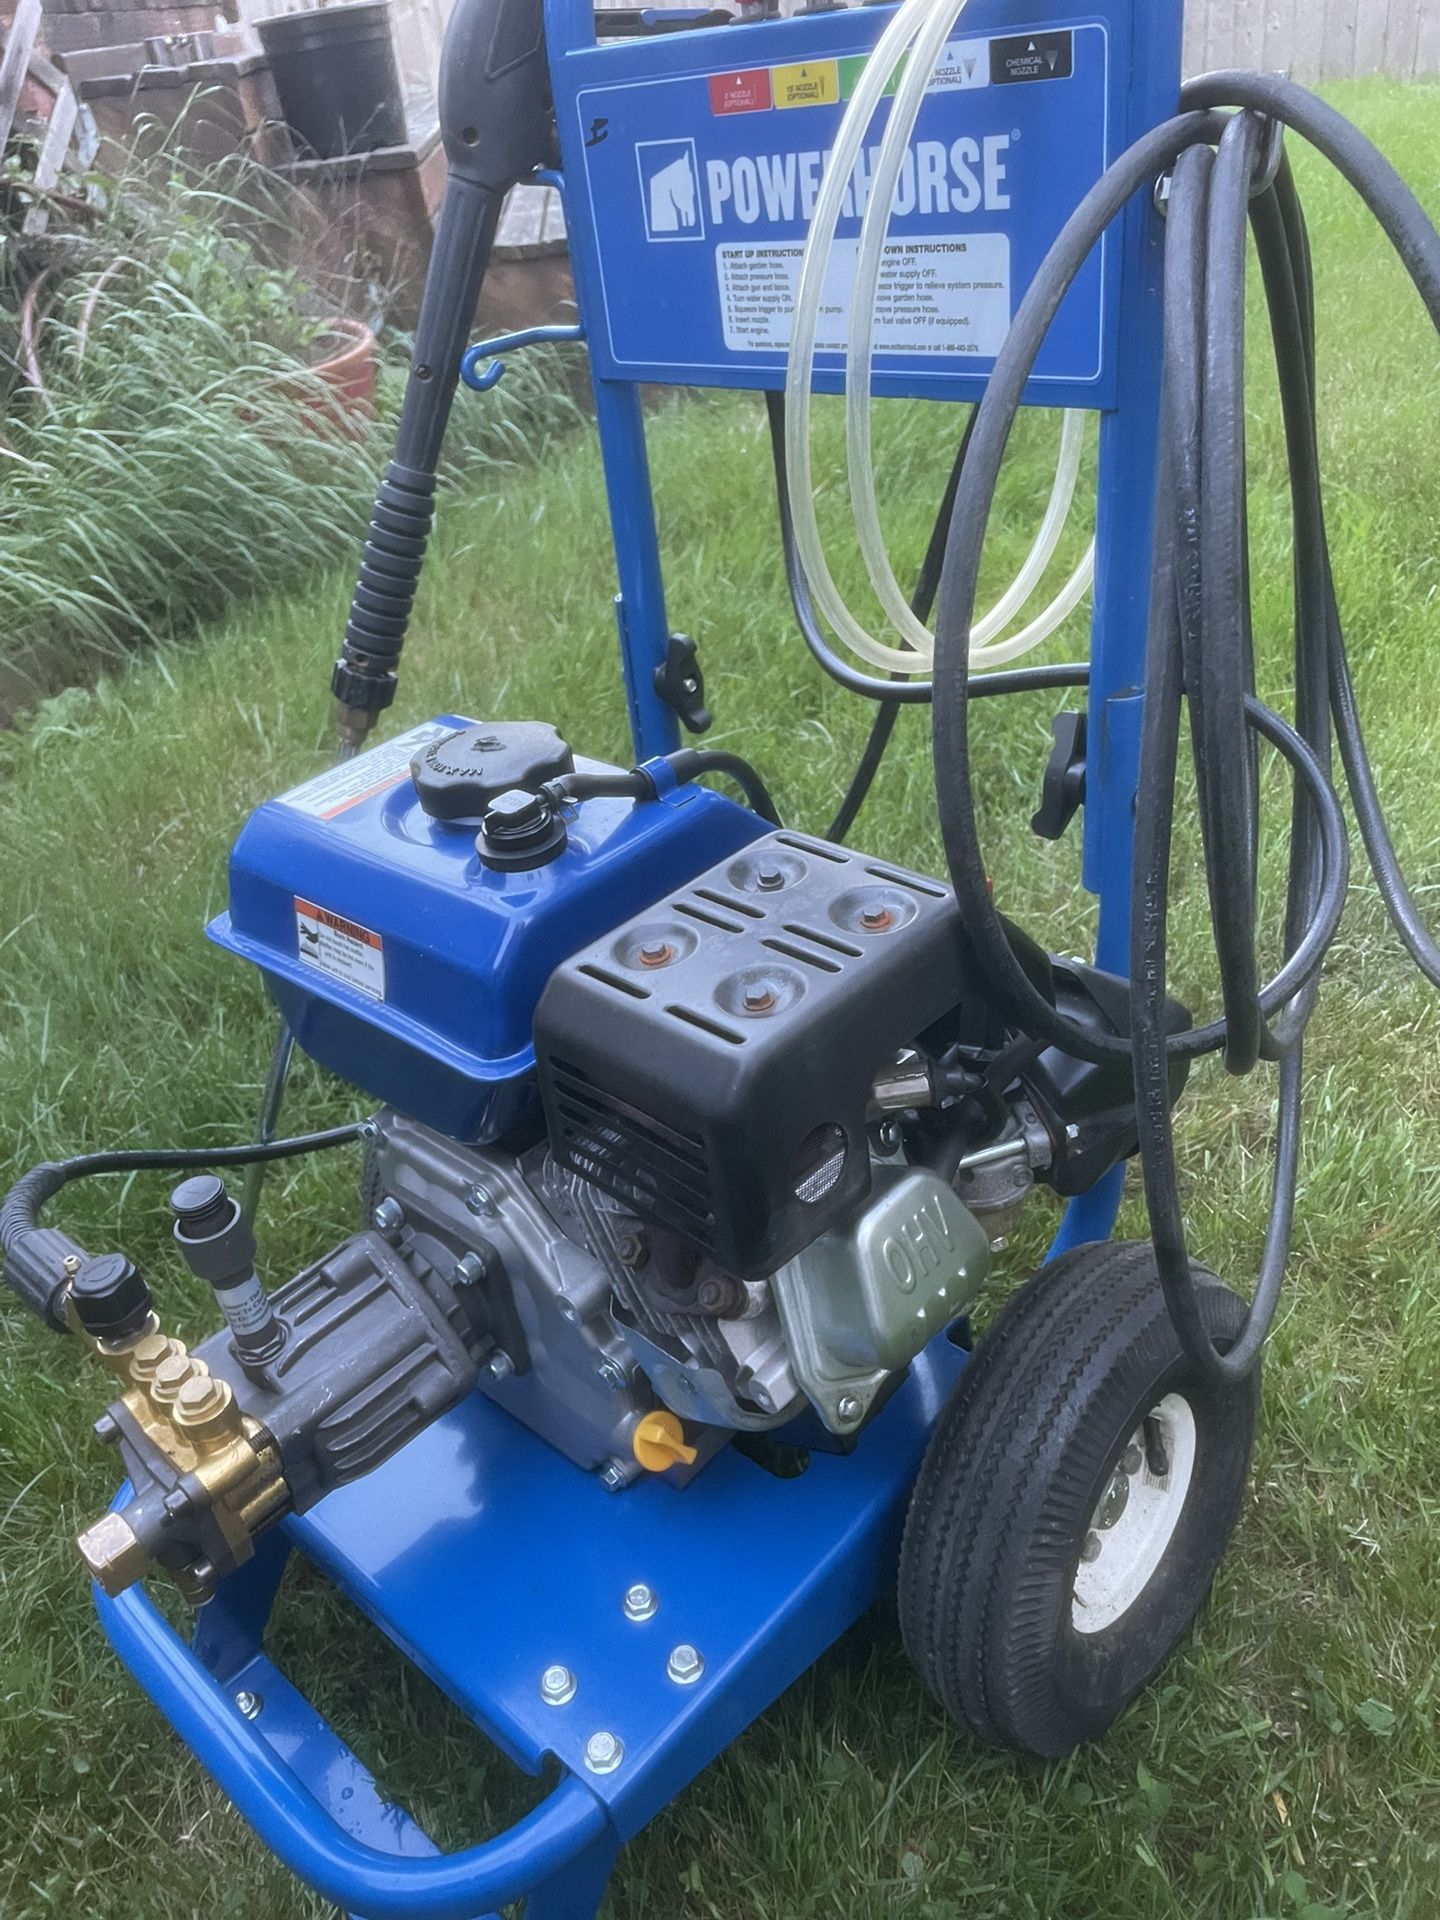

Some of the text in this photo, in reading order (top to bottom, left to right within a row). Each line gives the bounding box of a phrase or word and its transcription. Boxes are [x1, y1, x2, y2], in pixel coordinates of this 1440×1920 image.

[1005, 56, 1043, 68] CHEMICAL
[1010, 65, 1039, 76] NOZZLE
[722, 248, 805, 259] START UP INSTRUCTION
[884, 243, 967, 254] OWN INSTRUCTIONS
[881, 257, 918, 267] ngine OFF.
[899, 270, 921, 280] supply
[921, 268, 937, 278] OFF.
[893, 281, 915, 291] trigger
[916, 282, 923, 290] to
[947, 281, 972, 291] system
[893, 294, 915, 303] garden
[893, 306, 921, 315] pressure
[912, 316, 927, 325] OFF
[327, 914, 370, 944] WARNING
[882, 1194, 956, 1295] OHV
